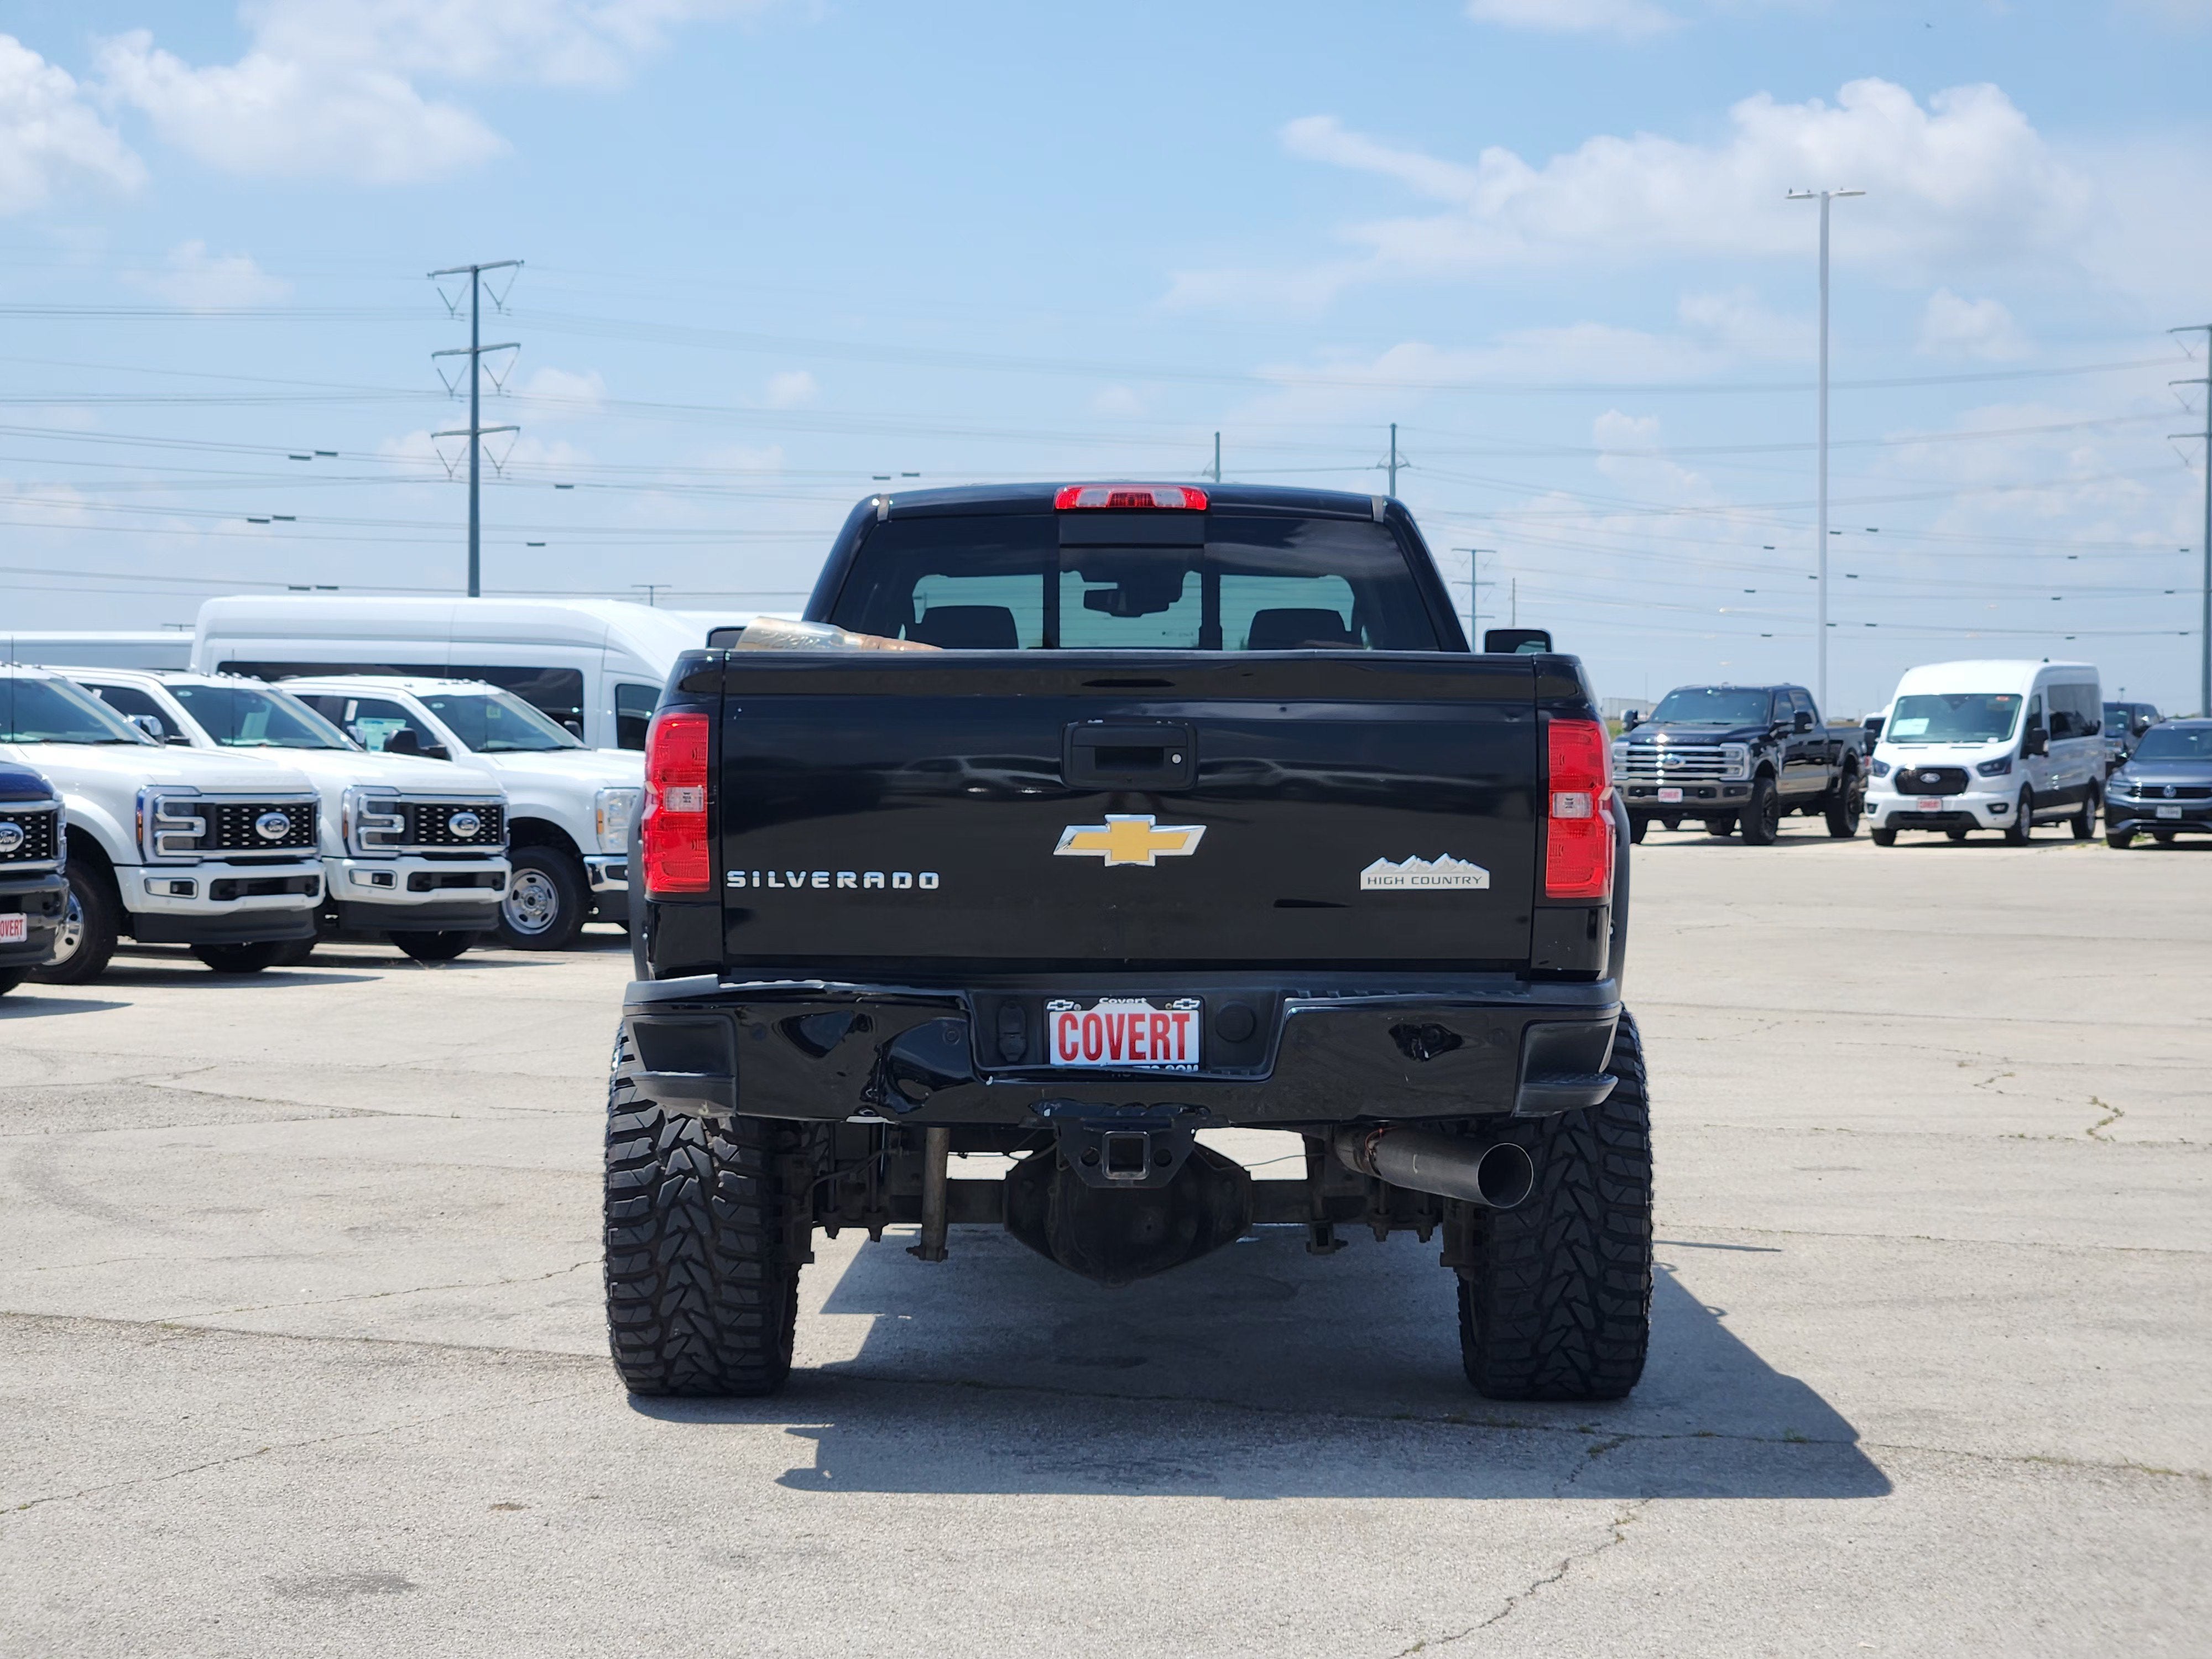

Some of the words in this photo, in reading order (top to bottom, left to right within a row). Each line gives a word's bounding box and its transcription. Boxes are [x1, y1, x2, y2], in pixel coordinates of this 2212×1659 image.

[726, 870, 939, 889] SILVERADO
[1367, 877, 1405, 885] HIGH
[1411, 876, 1483, 885] COUNTRY
[1058, 1013, 1190, 1061] COVERT
